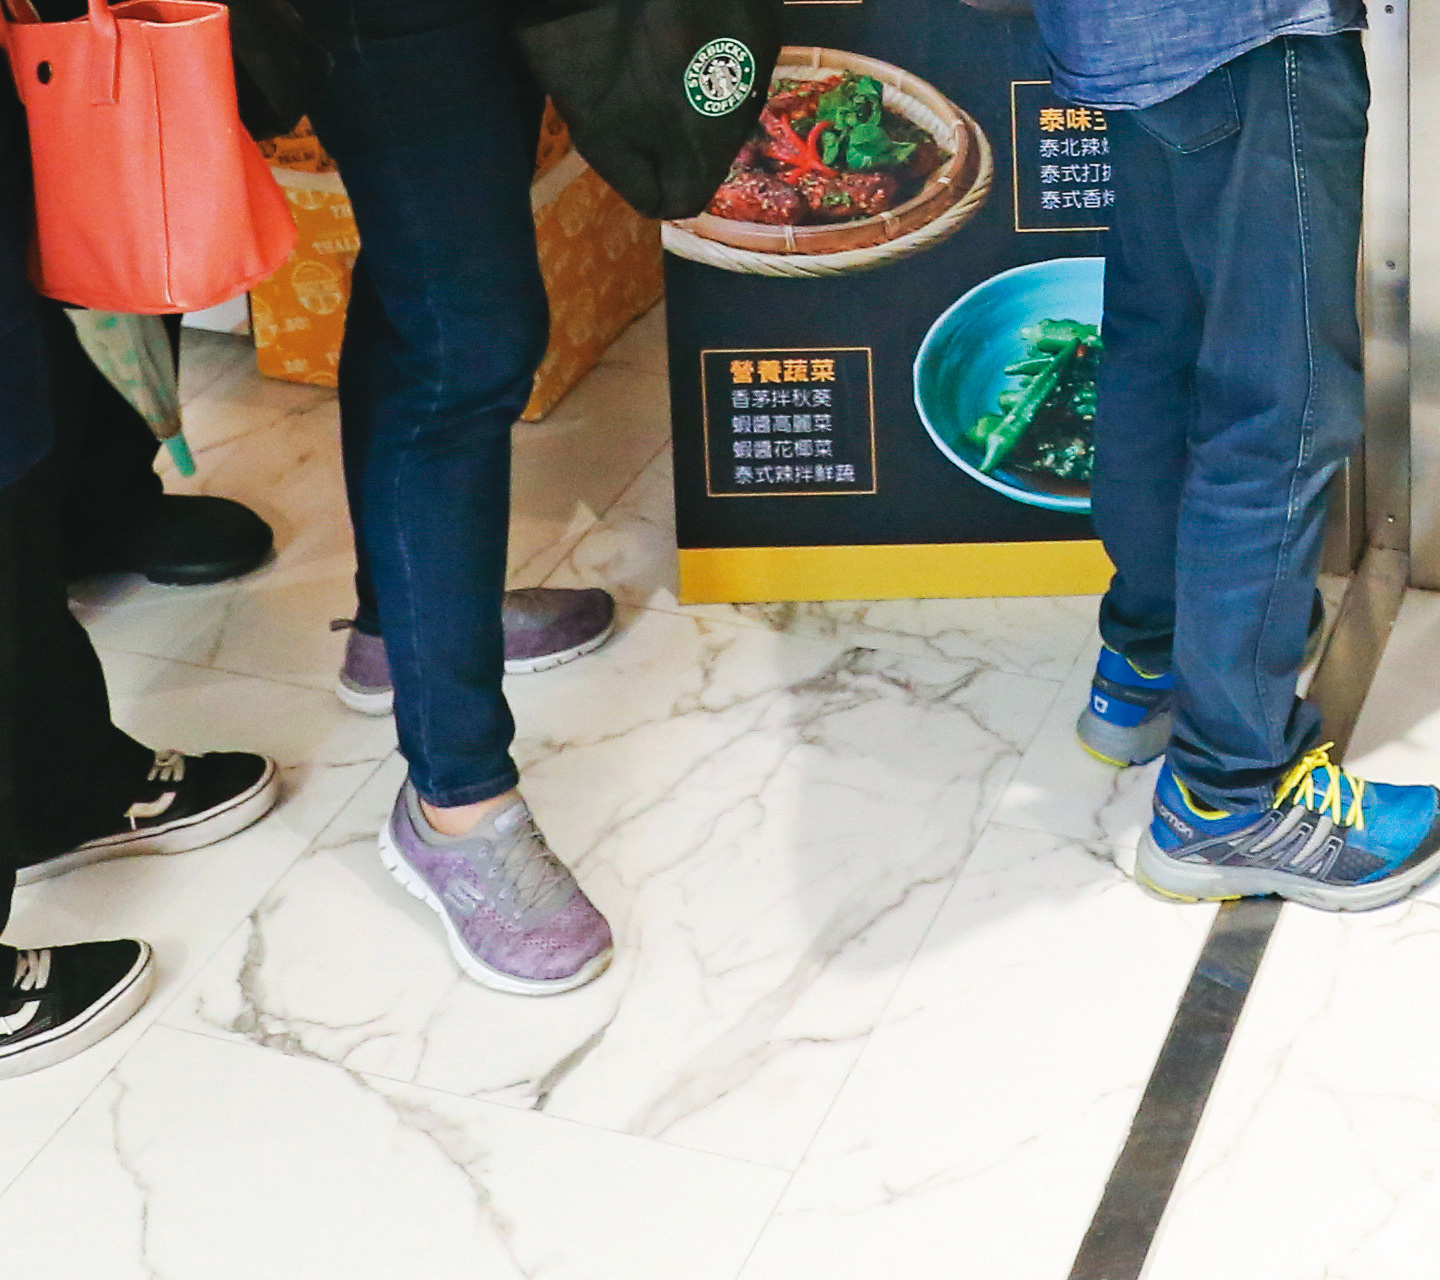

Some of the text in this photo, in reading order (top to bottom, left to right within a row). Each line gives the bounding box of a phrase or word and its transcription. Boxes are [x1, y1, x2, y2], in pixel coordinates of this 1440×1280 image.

[688, 42, 747, 88] STARBUCKS
[704, 82, 750, 112] COFFEE
[730, 358, 836, 384] 營養蔬菜
[731, 389, 833, 409] 香茅拌秋葵
